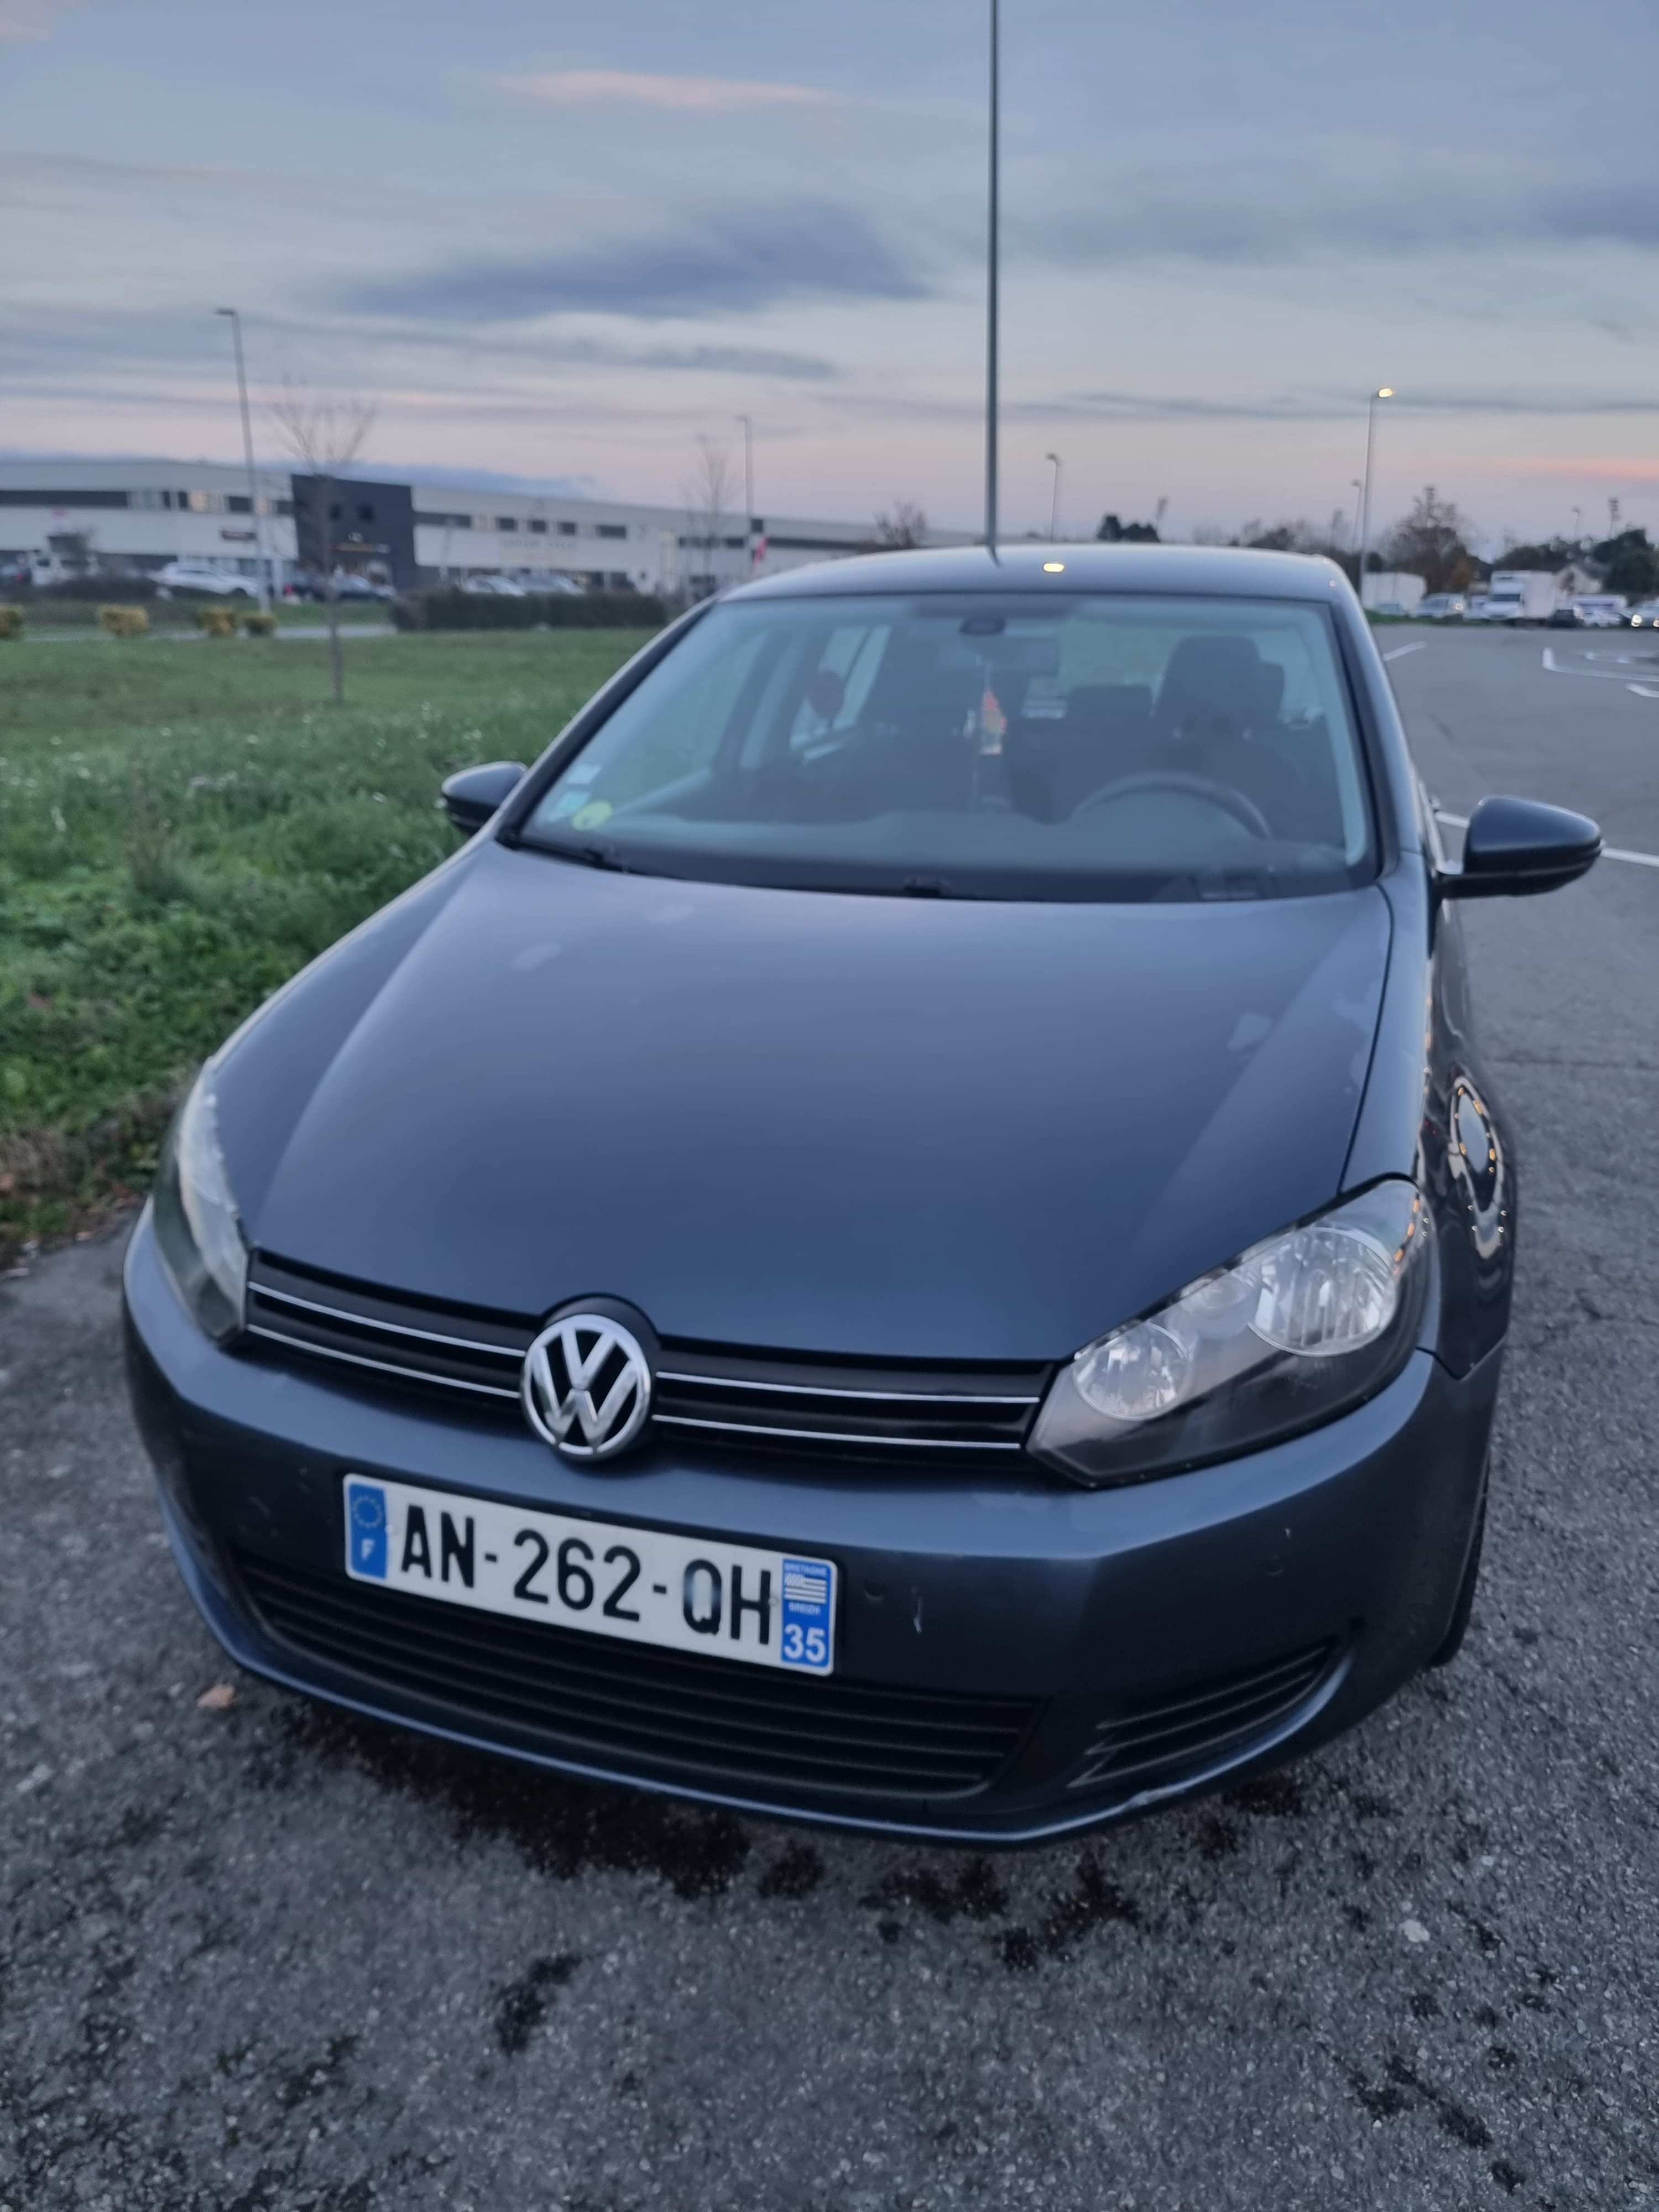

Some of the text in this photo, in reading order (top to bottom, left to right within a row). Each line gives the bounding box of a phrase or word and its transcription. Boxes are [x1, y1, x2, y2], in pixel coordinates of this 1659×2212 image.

[527, 1321, 643, 1449] VW
[361, 1539, 374, 1560] F
[401, 1505, 771, 1645] AN-262-QH
[784, 1624, 826, 1662] 35
